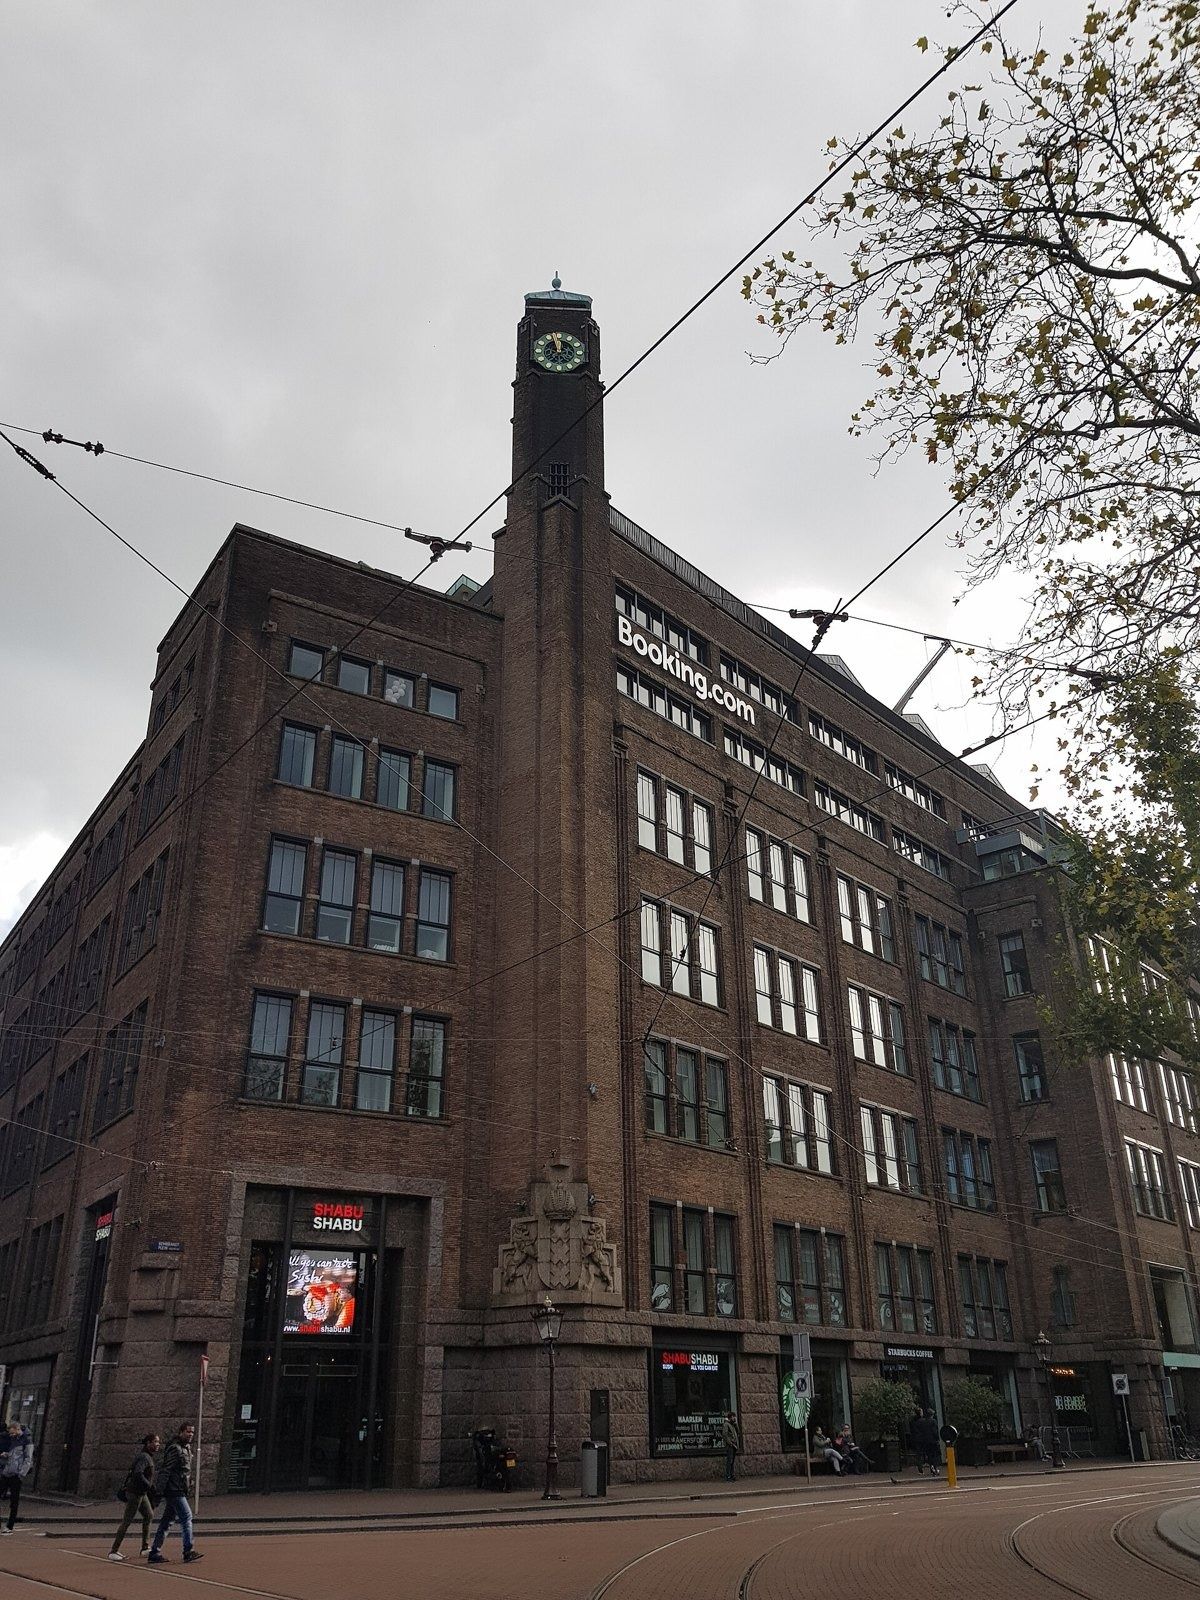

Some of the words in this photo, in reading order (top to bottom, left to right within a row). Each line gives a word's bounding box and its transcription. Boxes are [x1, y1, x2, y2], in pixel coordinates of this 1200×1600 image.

[618, 615, 756, 726] Booking.com
[314, 1203, 363, 1218] SHABU
[313, 1217, 363, 1232] SHABU
[95, 1225, 111, 1241] SHABU
[316, 1260, 332, 1268] can
[288, 1269, 324, 1284] Sushi
[887, 1347, 916, 1358] STARBUCKS
[916, 1350, 934, 1359] COFFEE
